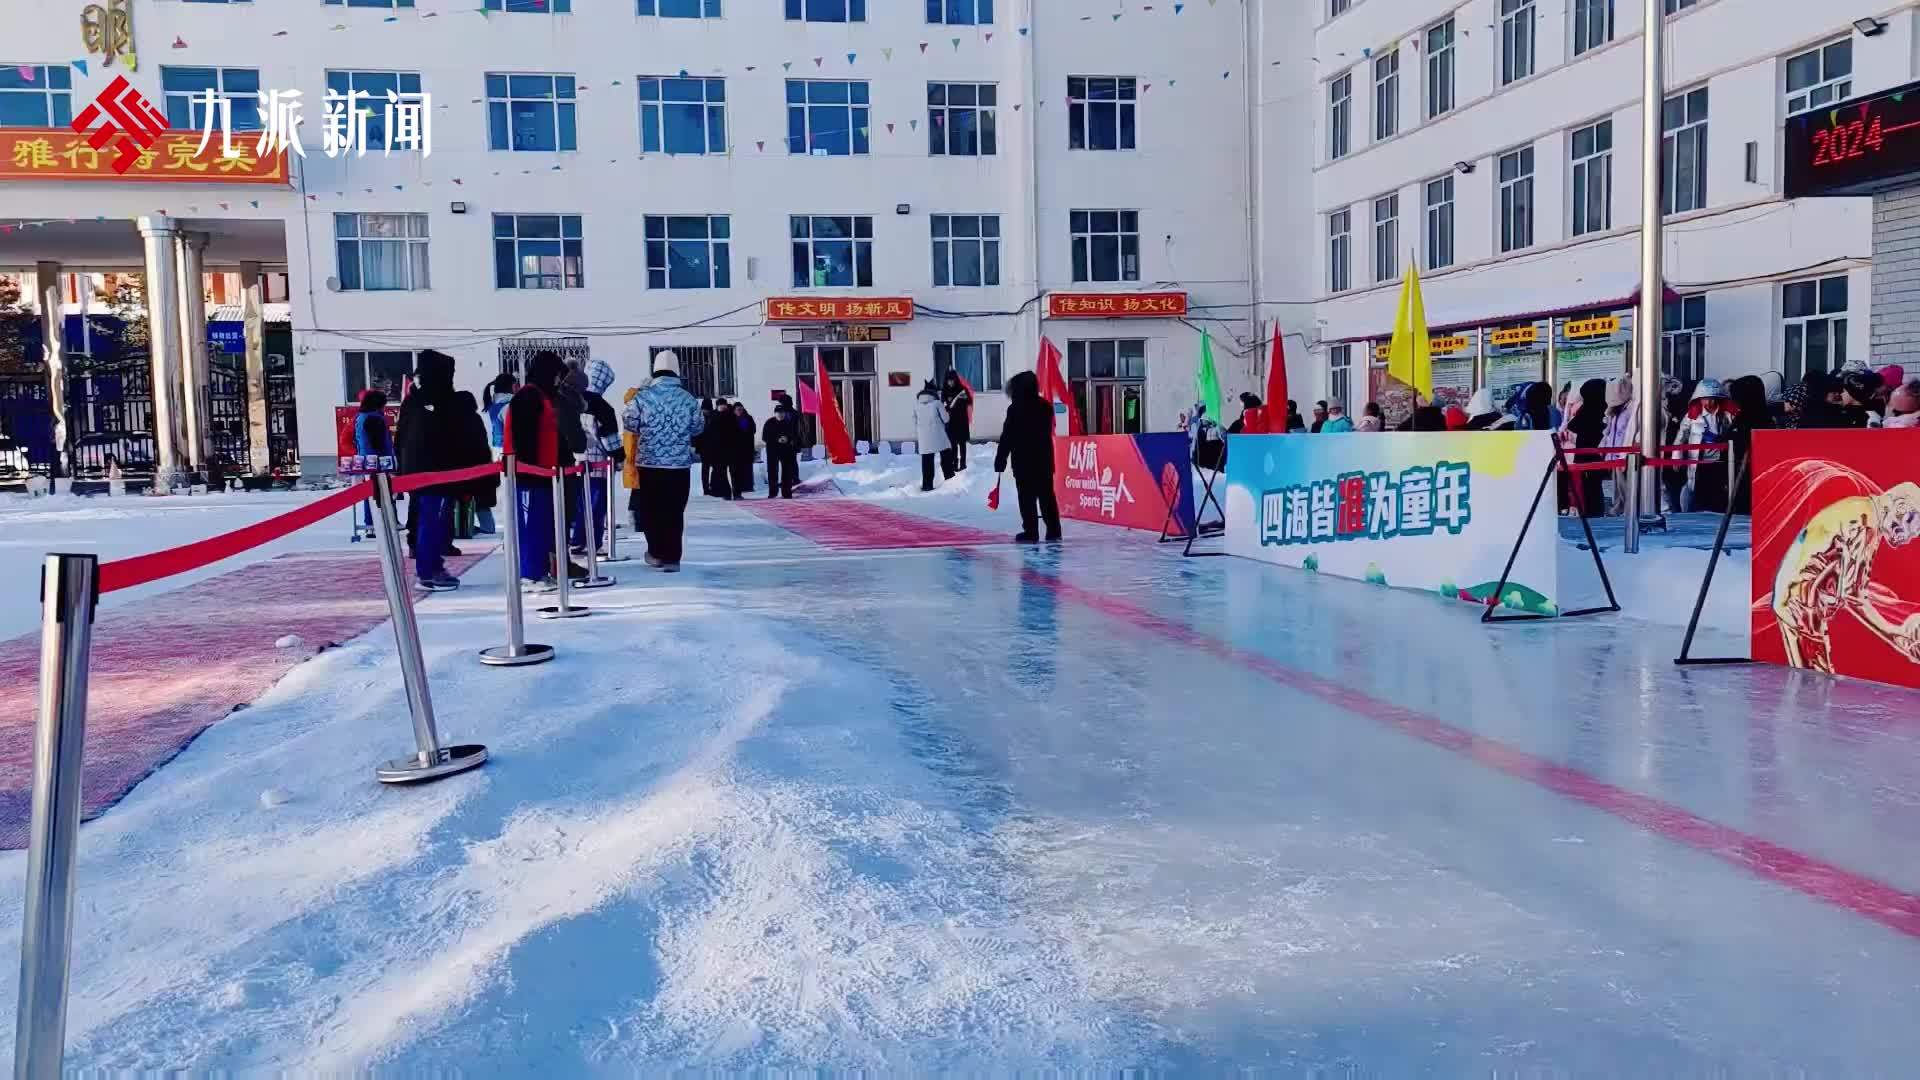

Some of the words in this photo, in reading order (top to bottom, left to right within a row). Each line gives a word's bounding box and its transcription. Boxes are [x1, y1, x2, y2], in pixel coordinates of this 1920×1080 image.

[777, 302, 836, 316] 传文明
[846, 302, 903, 316] 扬新风
[1059, 298, 1115, 311] 传知识
[1123, 297, 1177, 311] 扬文化
[1065, 475, 1082, 489] Grow
[1082, 476, 1097, 490] with
[1079, 493, 1100, 510] Sports
